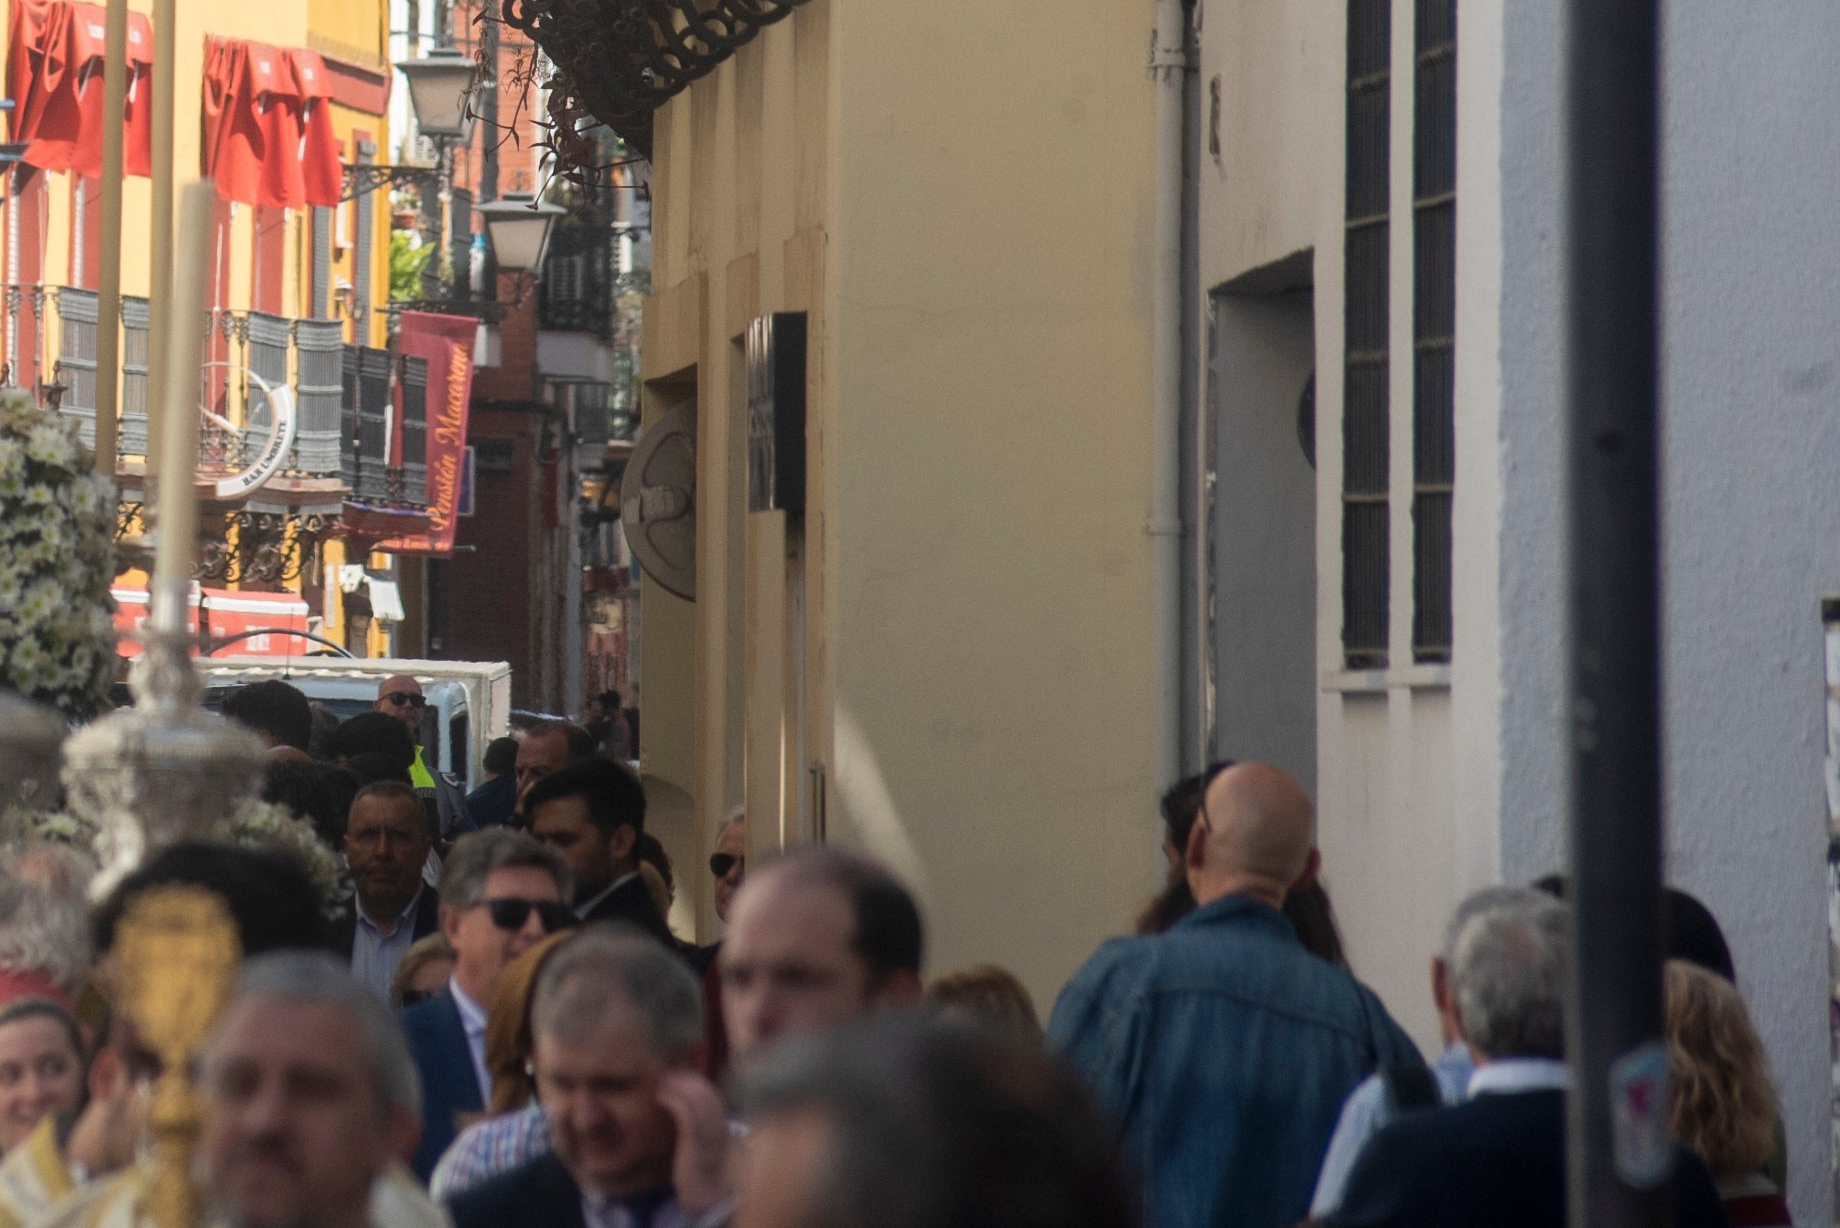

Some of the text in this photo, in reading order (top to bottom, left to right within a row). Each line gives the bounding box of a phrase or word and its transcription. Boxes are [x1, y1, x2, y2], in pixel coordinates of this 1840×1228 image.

[241, 468, 264, 487] BAR
[424, 340, 469, 532] Pensión Macarena
